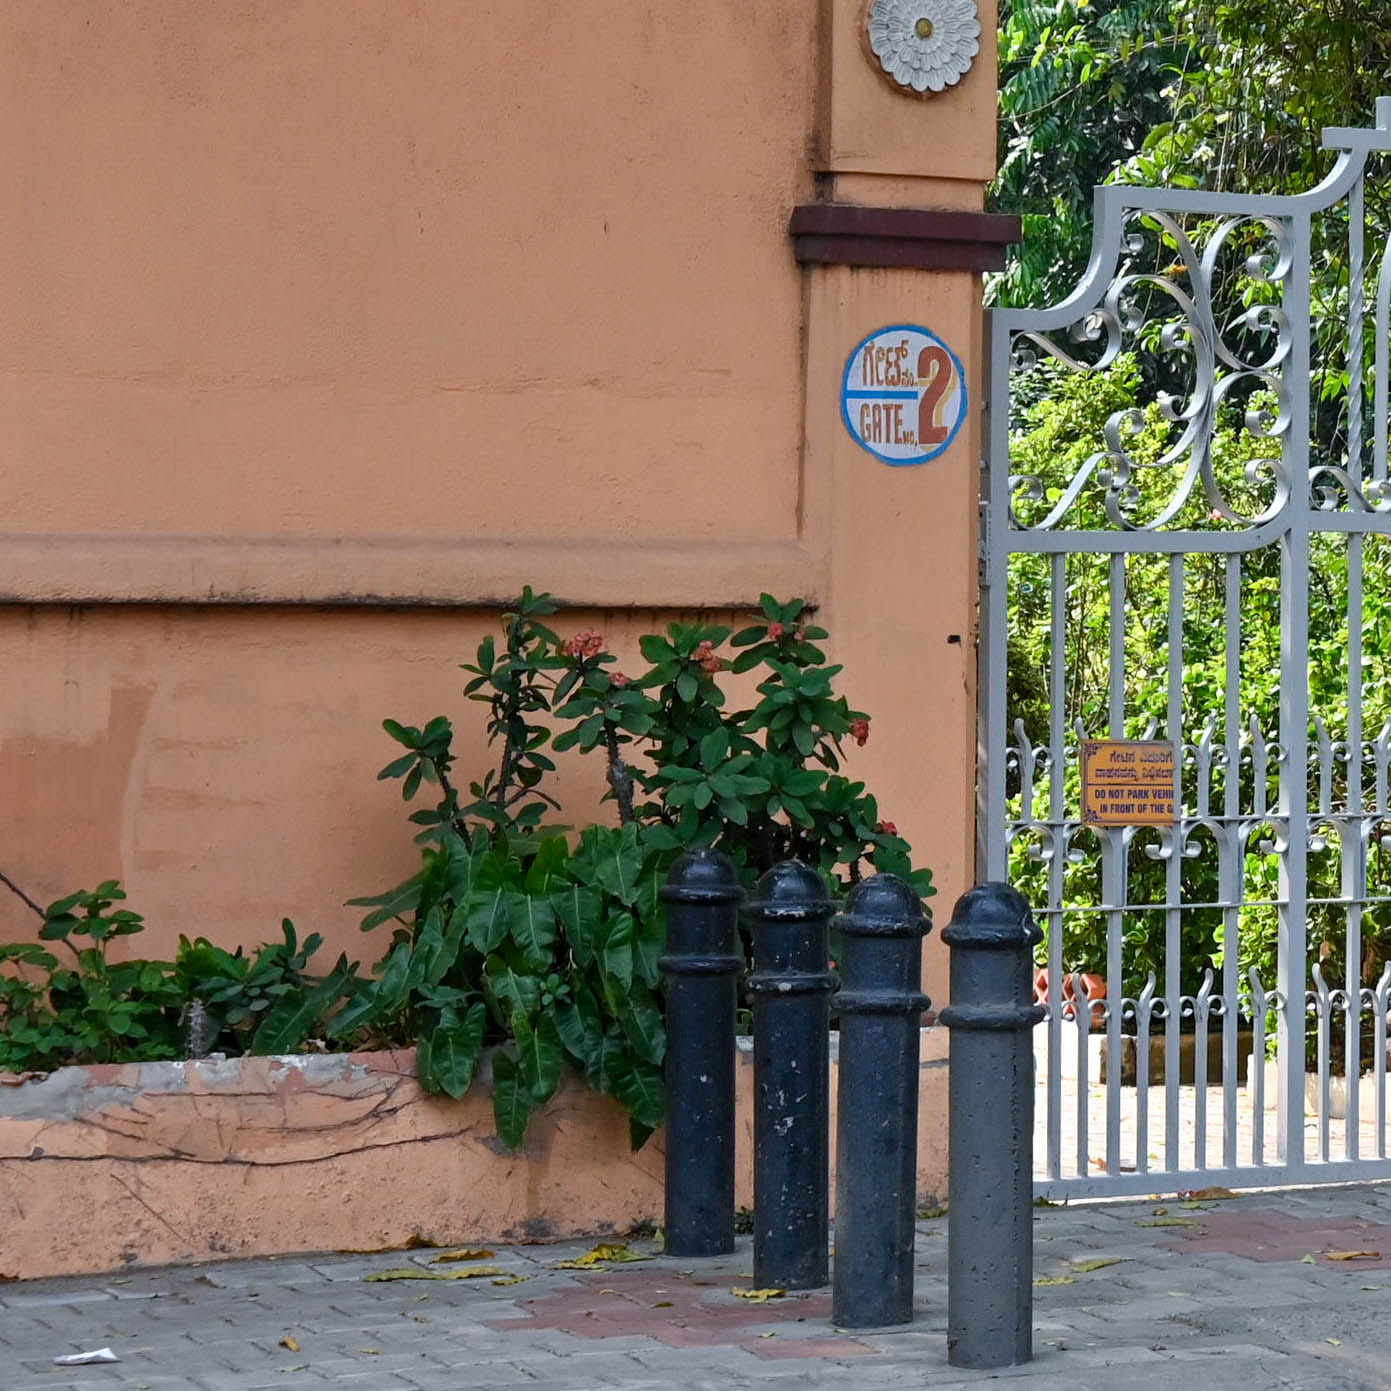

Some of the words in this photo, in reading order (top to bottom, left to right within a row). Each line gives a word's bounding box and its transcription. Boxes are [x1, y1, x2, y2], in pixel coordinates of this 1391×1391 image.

[863, 339, 909, 387] ಗೇಟ್
[917, 345, 952, 445] 2
[860, 403, 903, 444] GATE
[1095, 789, 1106, 799] DO
[1109, 789, 1124, 799] NOT
[1128, 789, 1149, 799] PARK
[1100, 804, 1109, 813] IN
[1111, 804, 1135, 814] FRONT
[1138, 804, 1147, 814] OF
[1150, 804, 1164, 814] THE
